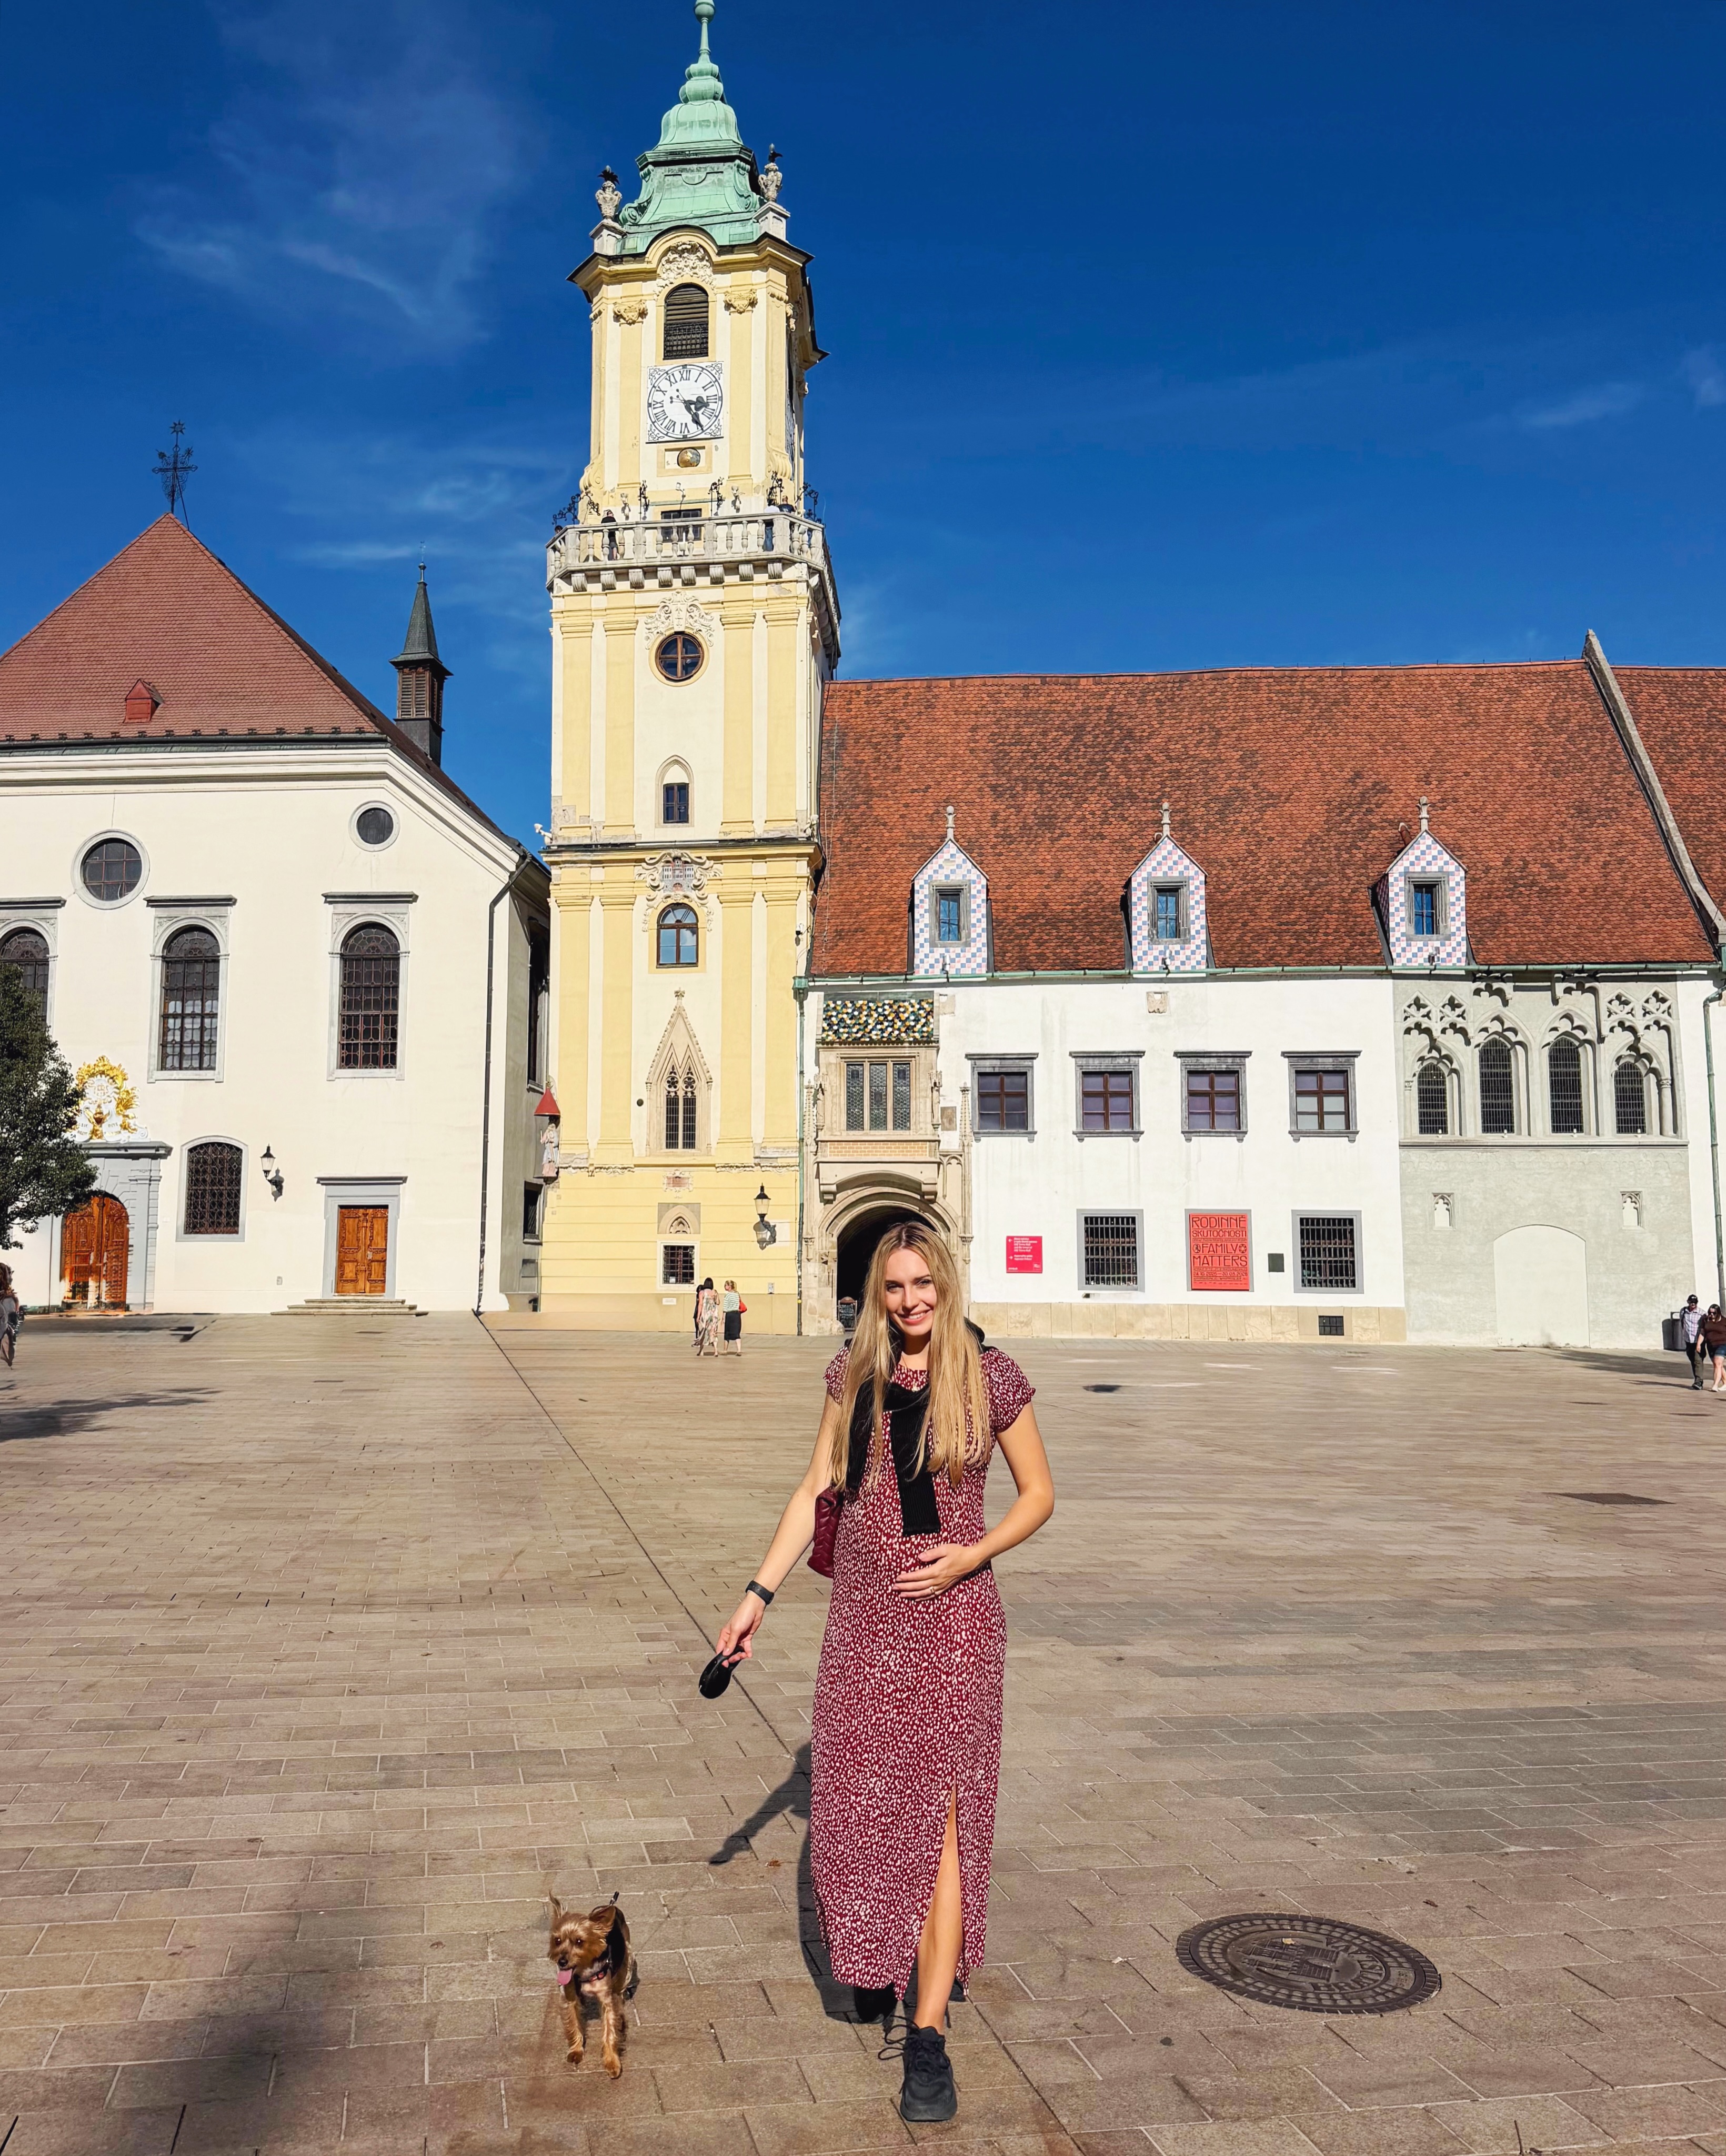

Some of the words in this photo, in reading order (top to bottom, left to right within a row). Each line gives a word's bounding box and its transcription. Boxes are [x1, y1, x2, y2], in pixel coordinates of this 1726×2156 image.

[665, 373, 678, 387] XI
[679, 370, 691, 382] XII
[694, 372, 701, 383] I
[656, 385, 667, 396] X
[701, 381, 714, 392] II
[706, 394, 717, 404] III
[653, 400, 664, 410] IX
[654, 409, 668, 426] VIII
[664, 419, 676, 433] VII
[679, 423, 690, 434] VI
[1191, 1215, 1247, 1228] RODINNÉ
[1192, 1229, 1247, 1237] SKUTOČNOSTI
[1202, 1243, 1238, 1253] FAMILY
[1192, 1255, 1248, 1266] MATTERS
[1310, 1938, 1383, 1992] BRATISLAVA
